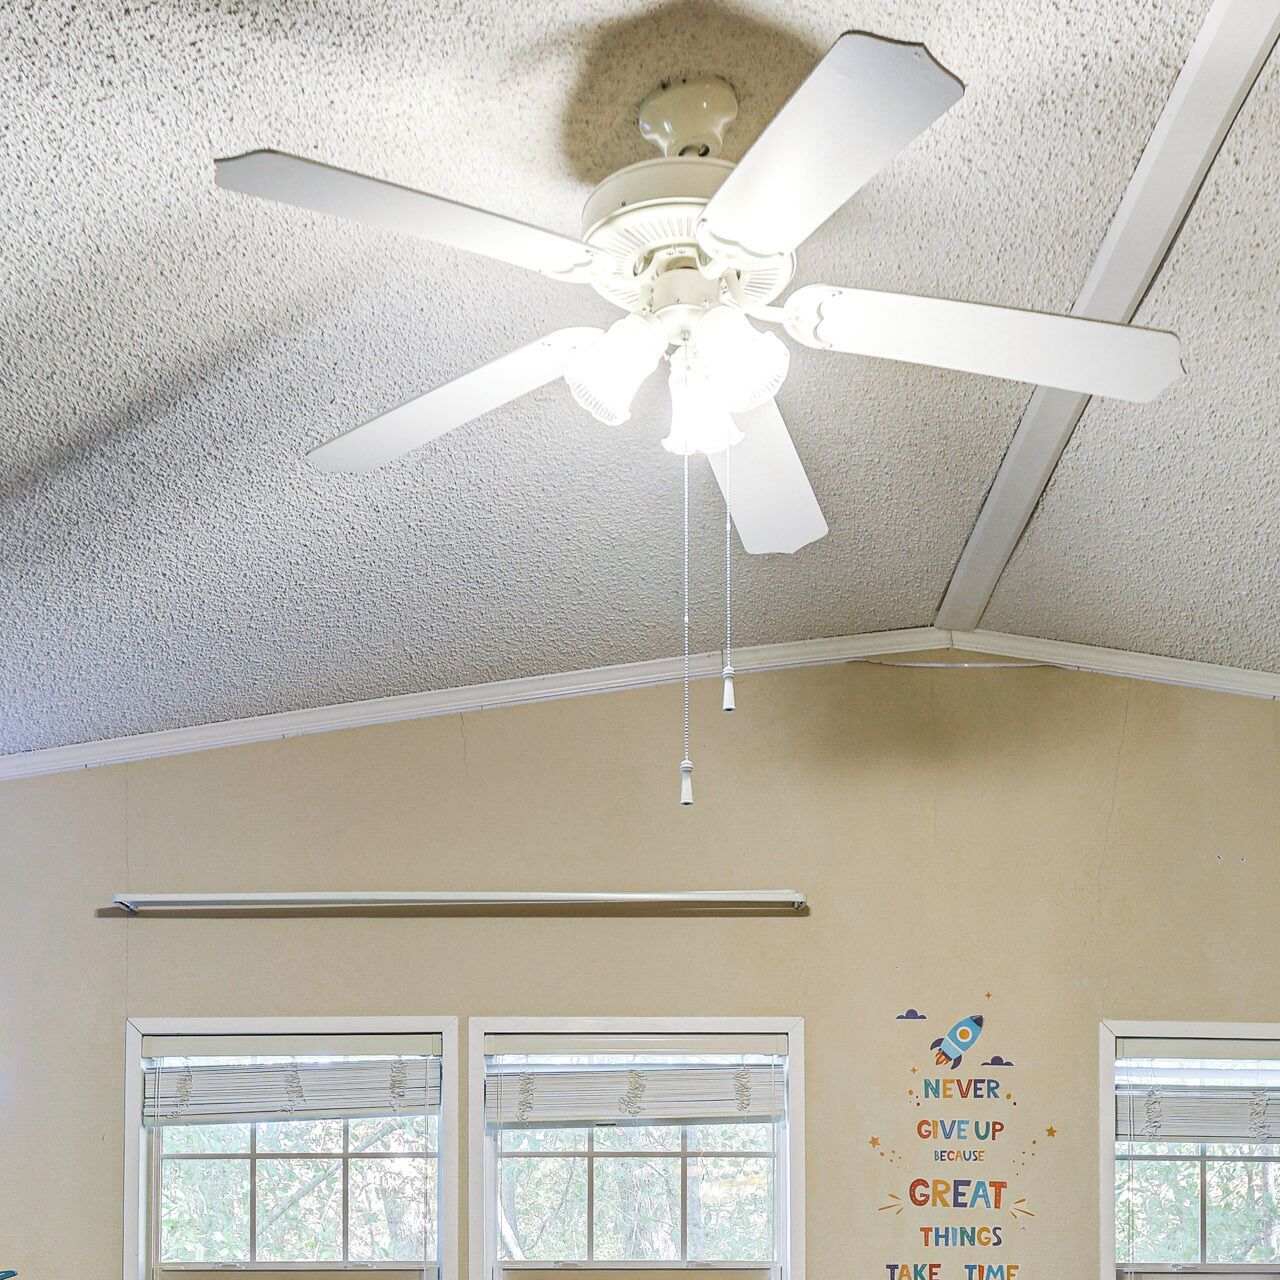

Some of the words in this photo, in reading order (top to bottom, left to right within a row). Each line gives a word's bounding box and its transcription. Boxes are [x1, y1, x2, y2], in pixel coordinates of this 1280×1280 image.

[924, 1079, 1000, 1099] NEVER
[917, 1119, 970, 1140] GIVE
[974, 1120, 1005, 1141] UP
[934, 1150, 985, 1162] BECAUSE
[909, 1178, 1008, 1209] GREAT
[920, 1226, 1002, 1247] THINGS
